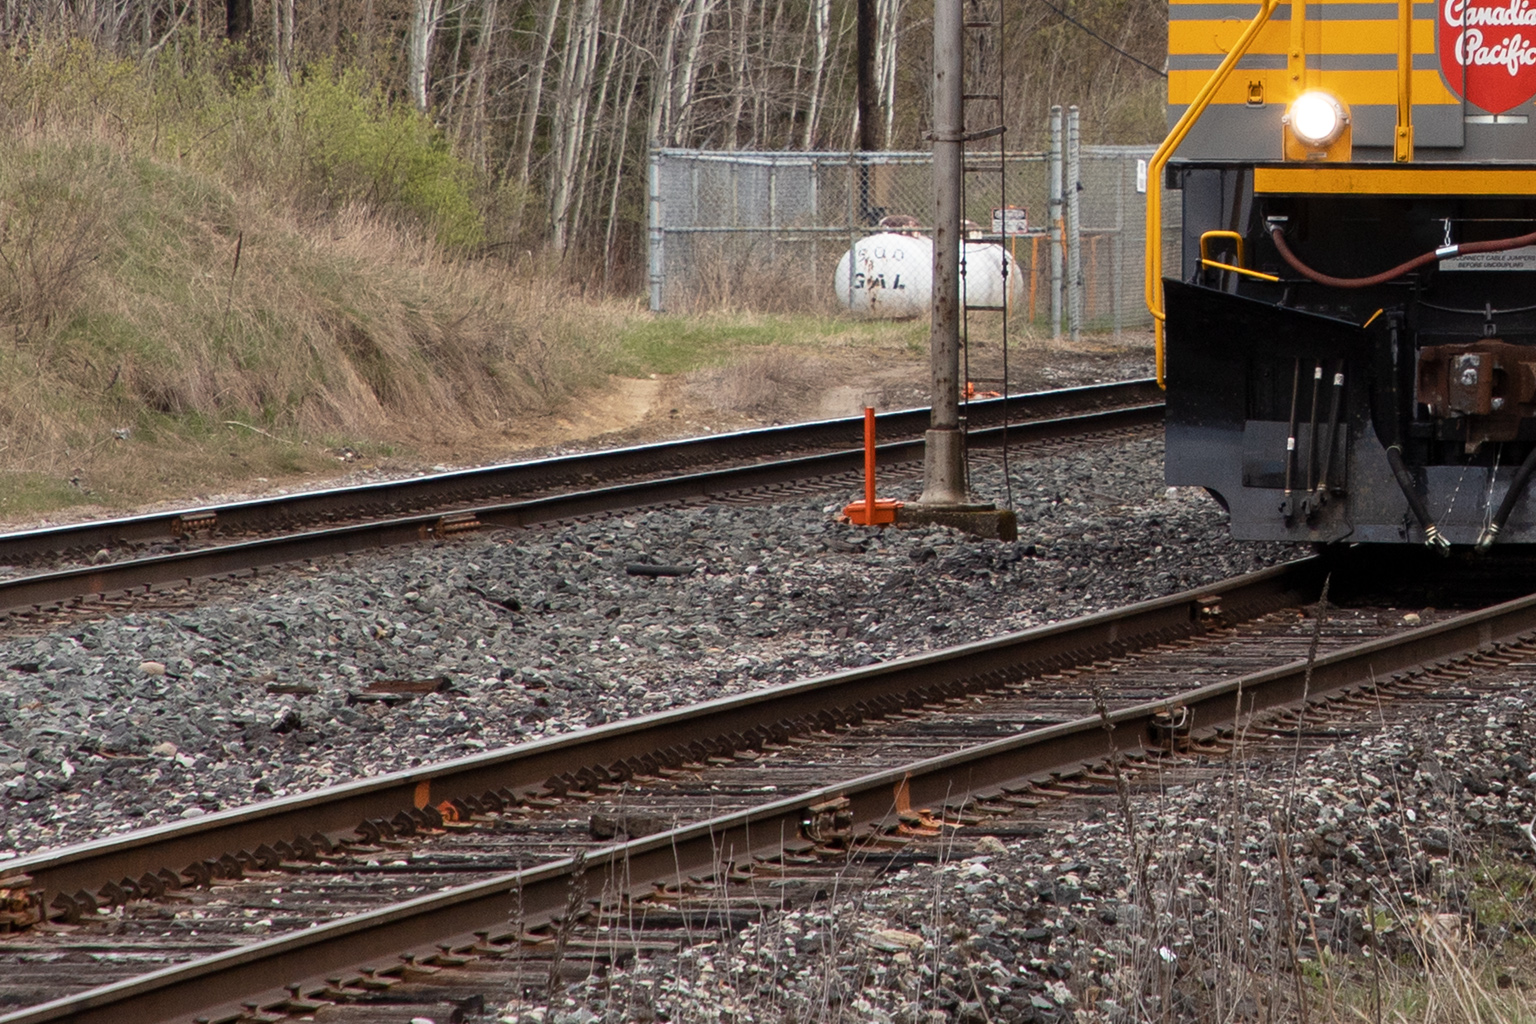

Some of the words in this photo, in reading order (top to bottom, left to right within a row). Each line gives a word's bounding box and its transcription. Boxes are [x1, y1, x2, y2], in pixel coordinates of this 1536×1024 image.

[1485, 254, 1506, 262] CABLE
[1507, 254, 1536, 262] JUMPERS
[1457, 261, 1483, 269] BEFORE
[854, 272, 906, 291] GAL
